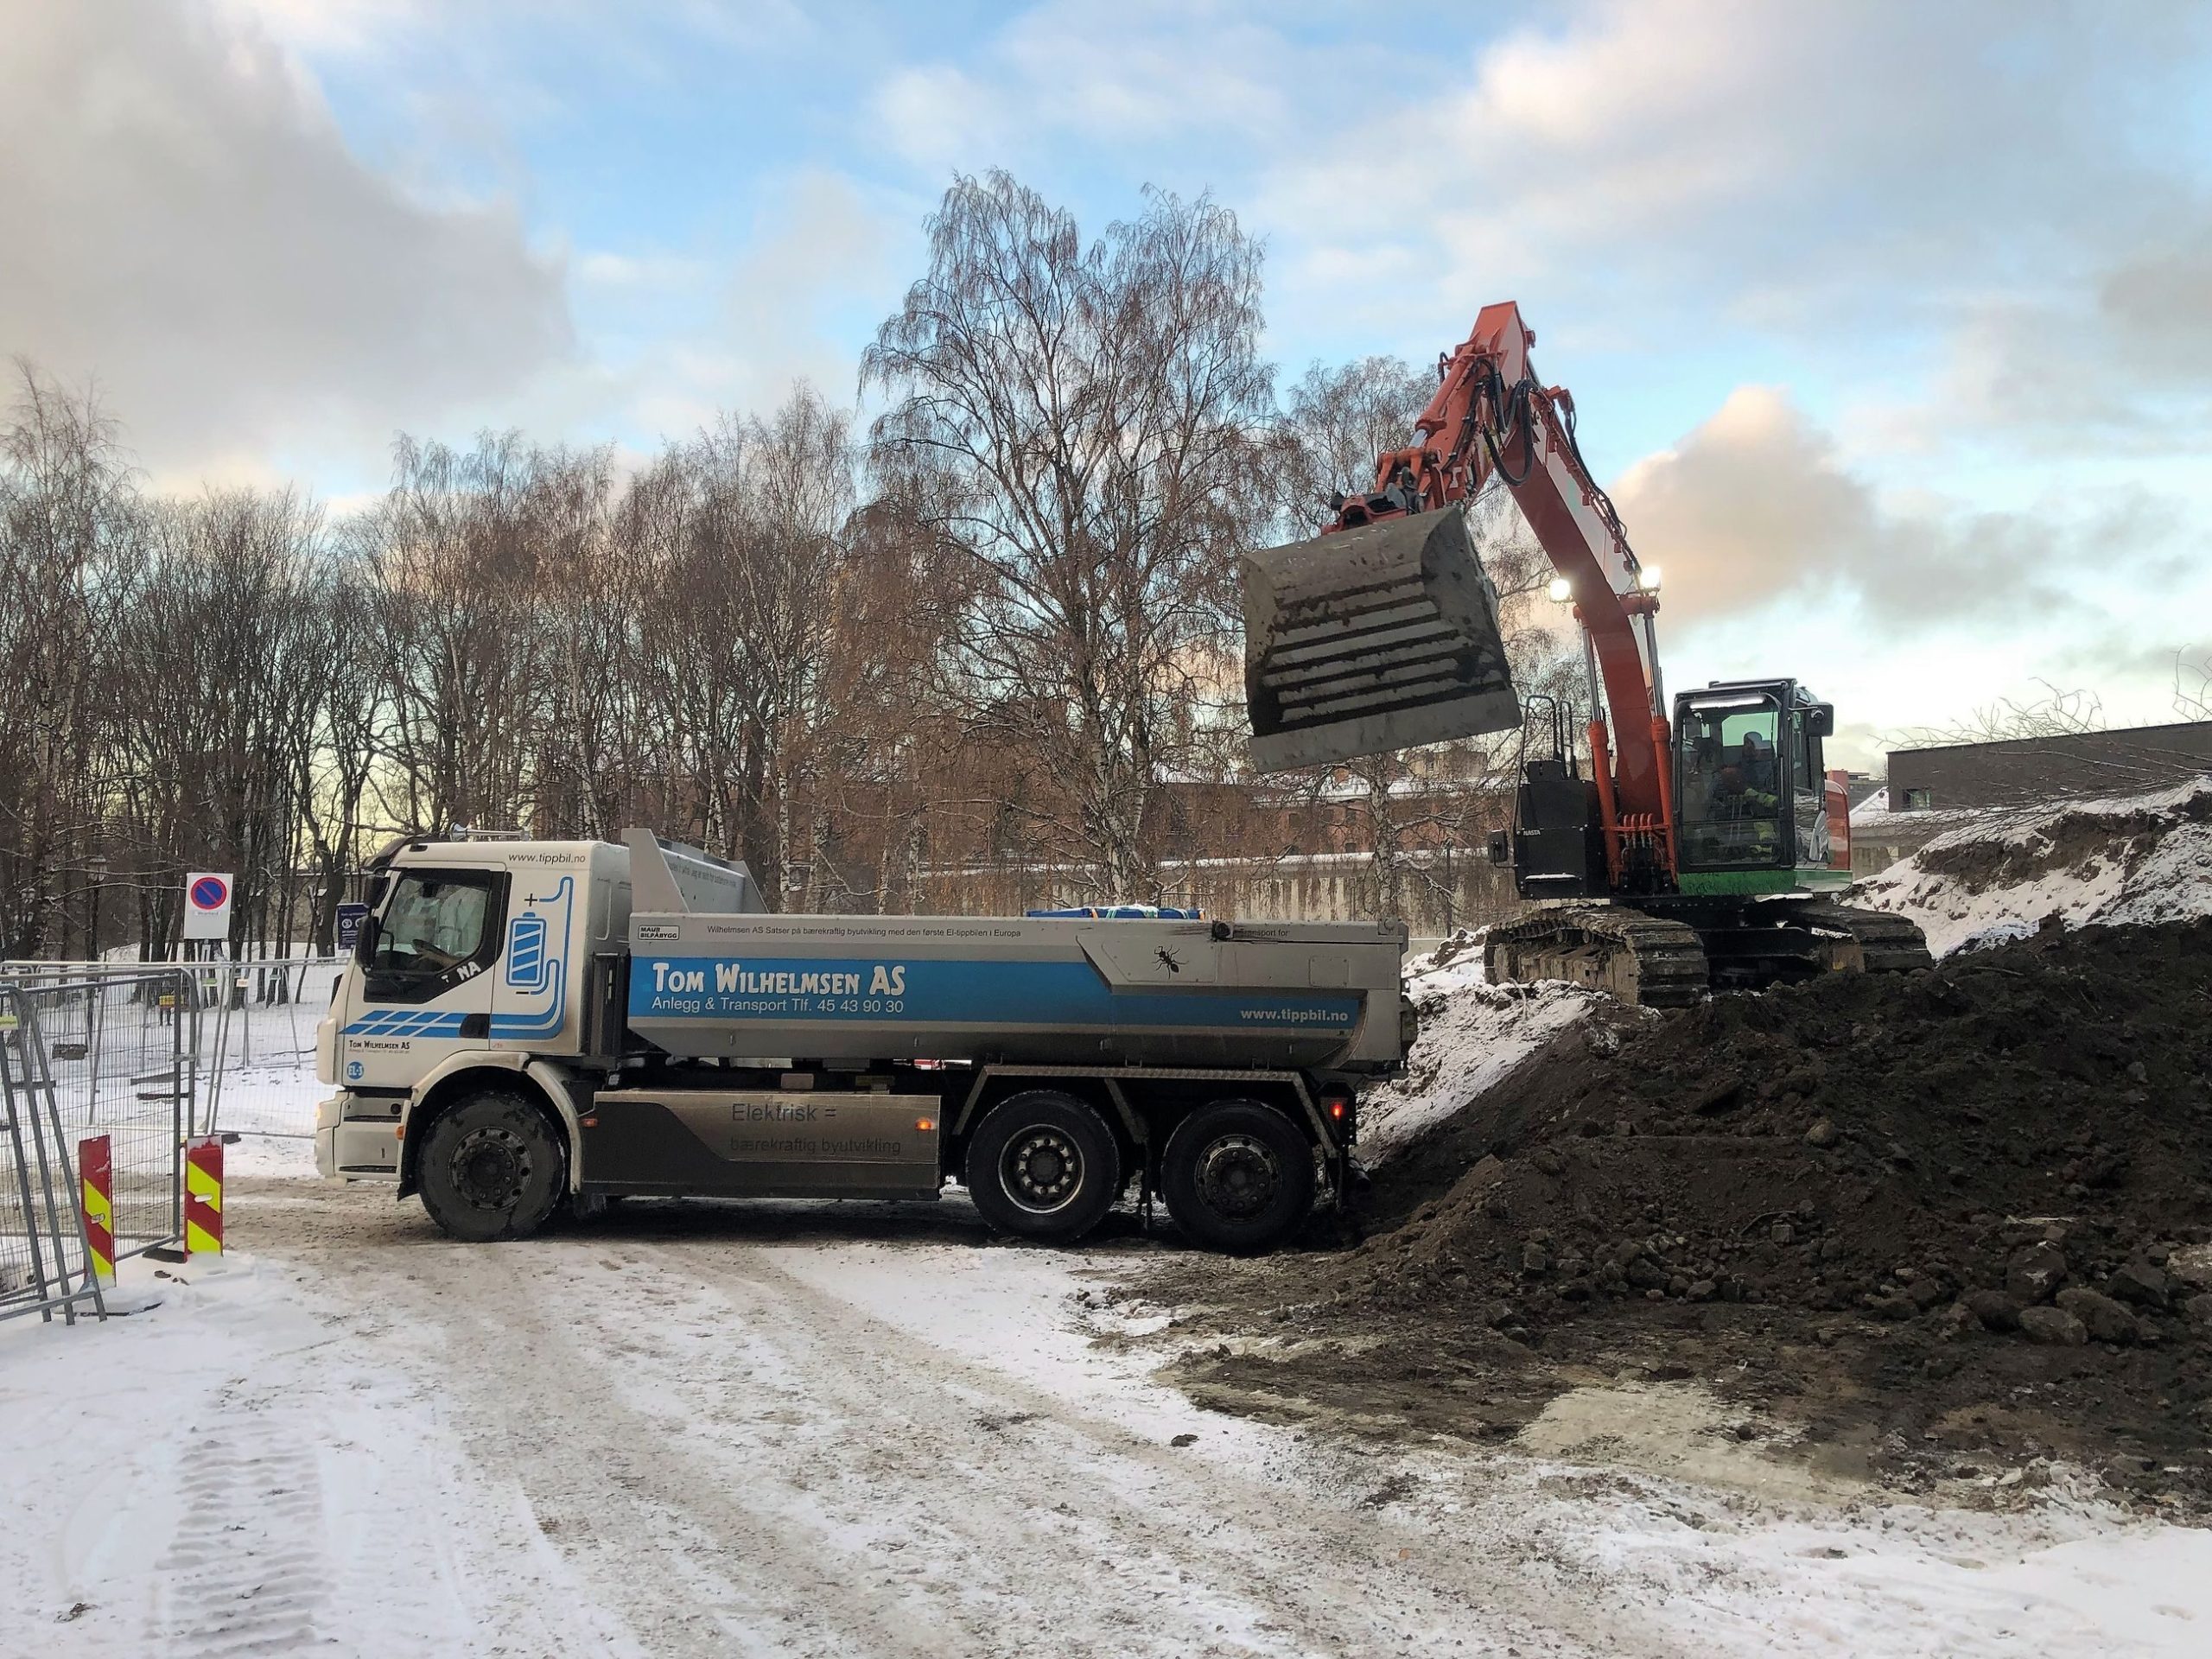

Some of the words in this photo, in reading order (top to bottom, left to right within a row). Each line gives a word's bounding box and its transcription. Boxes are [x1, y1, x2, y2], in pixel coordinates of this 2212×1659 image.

[509, 853, 586, 865] www.tippbil.no
[708, 925, 750, 934] Wilhelmsen
[766, 926, 790, 935] Satser
[791, 926, 801, 936] på
[803, 927, 845, 937] bærekraftig
[847, 928, 887, 938] byutvikling
[946, 929, 988, 938] El-tippbilen
[994, 930, 1021, 938] Europa
[1278, 928, 1288, 937] for
[652, 963, 704, 993] TOM
[715, 963, 861, 995] WILHELMSEN
[869, 965, 906, 996] AS
[652, 996, 700, 1014] Anlegg
[705, 997, 715, 1011] &
[721, 997, 786, 1014] Transport
[791, 998, 812, 1012] Tlf.
[817, 999, 836, 1012] 45
[840, 1000, 859, 1013] 43
[863, 1000, 881, 1014] 90
[886, 1001, 904, 1014] 30
[1240, 1008, 1349, 1023] www.tippbil.no
[401, 1041, 410, 1050] AS
[732, 1103, 818, 1122] Elektrisk
[730, 1135, 817, 1154] bærekraftig
[822, 1137, 901, 1156] byutvikling
